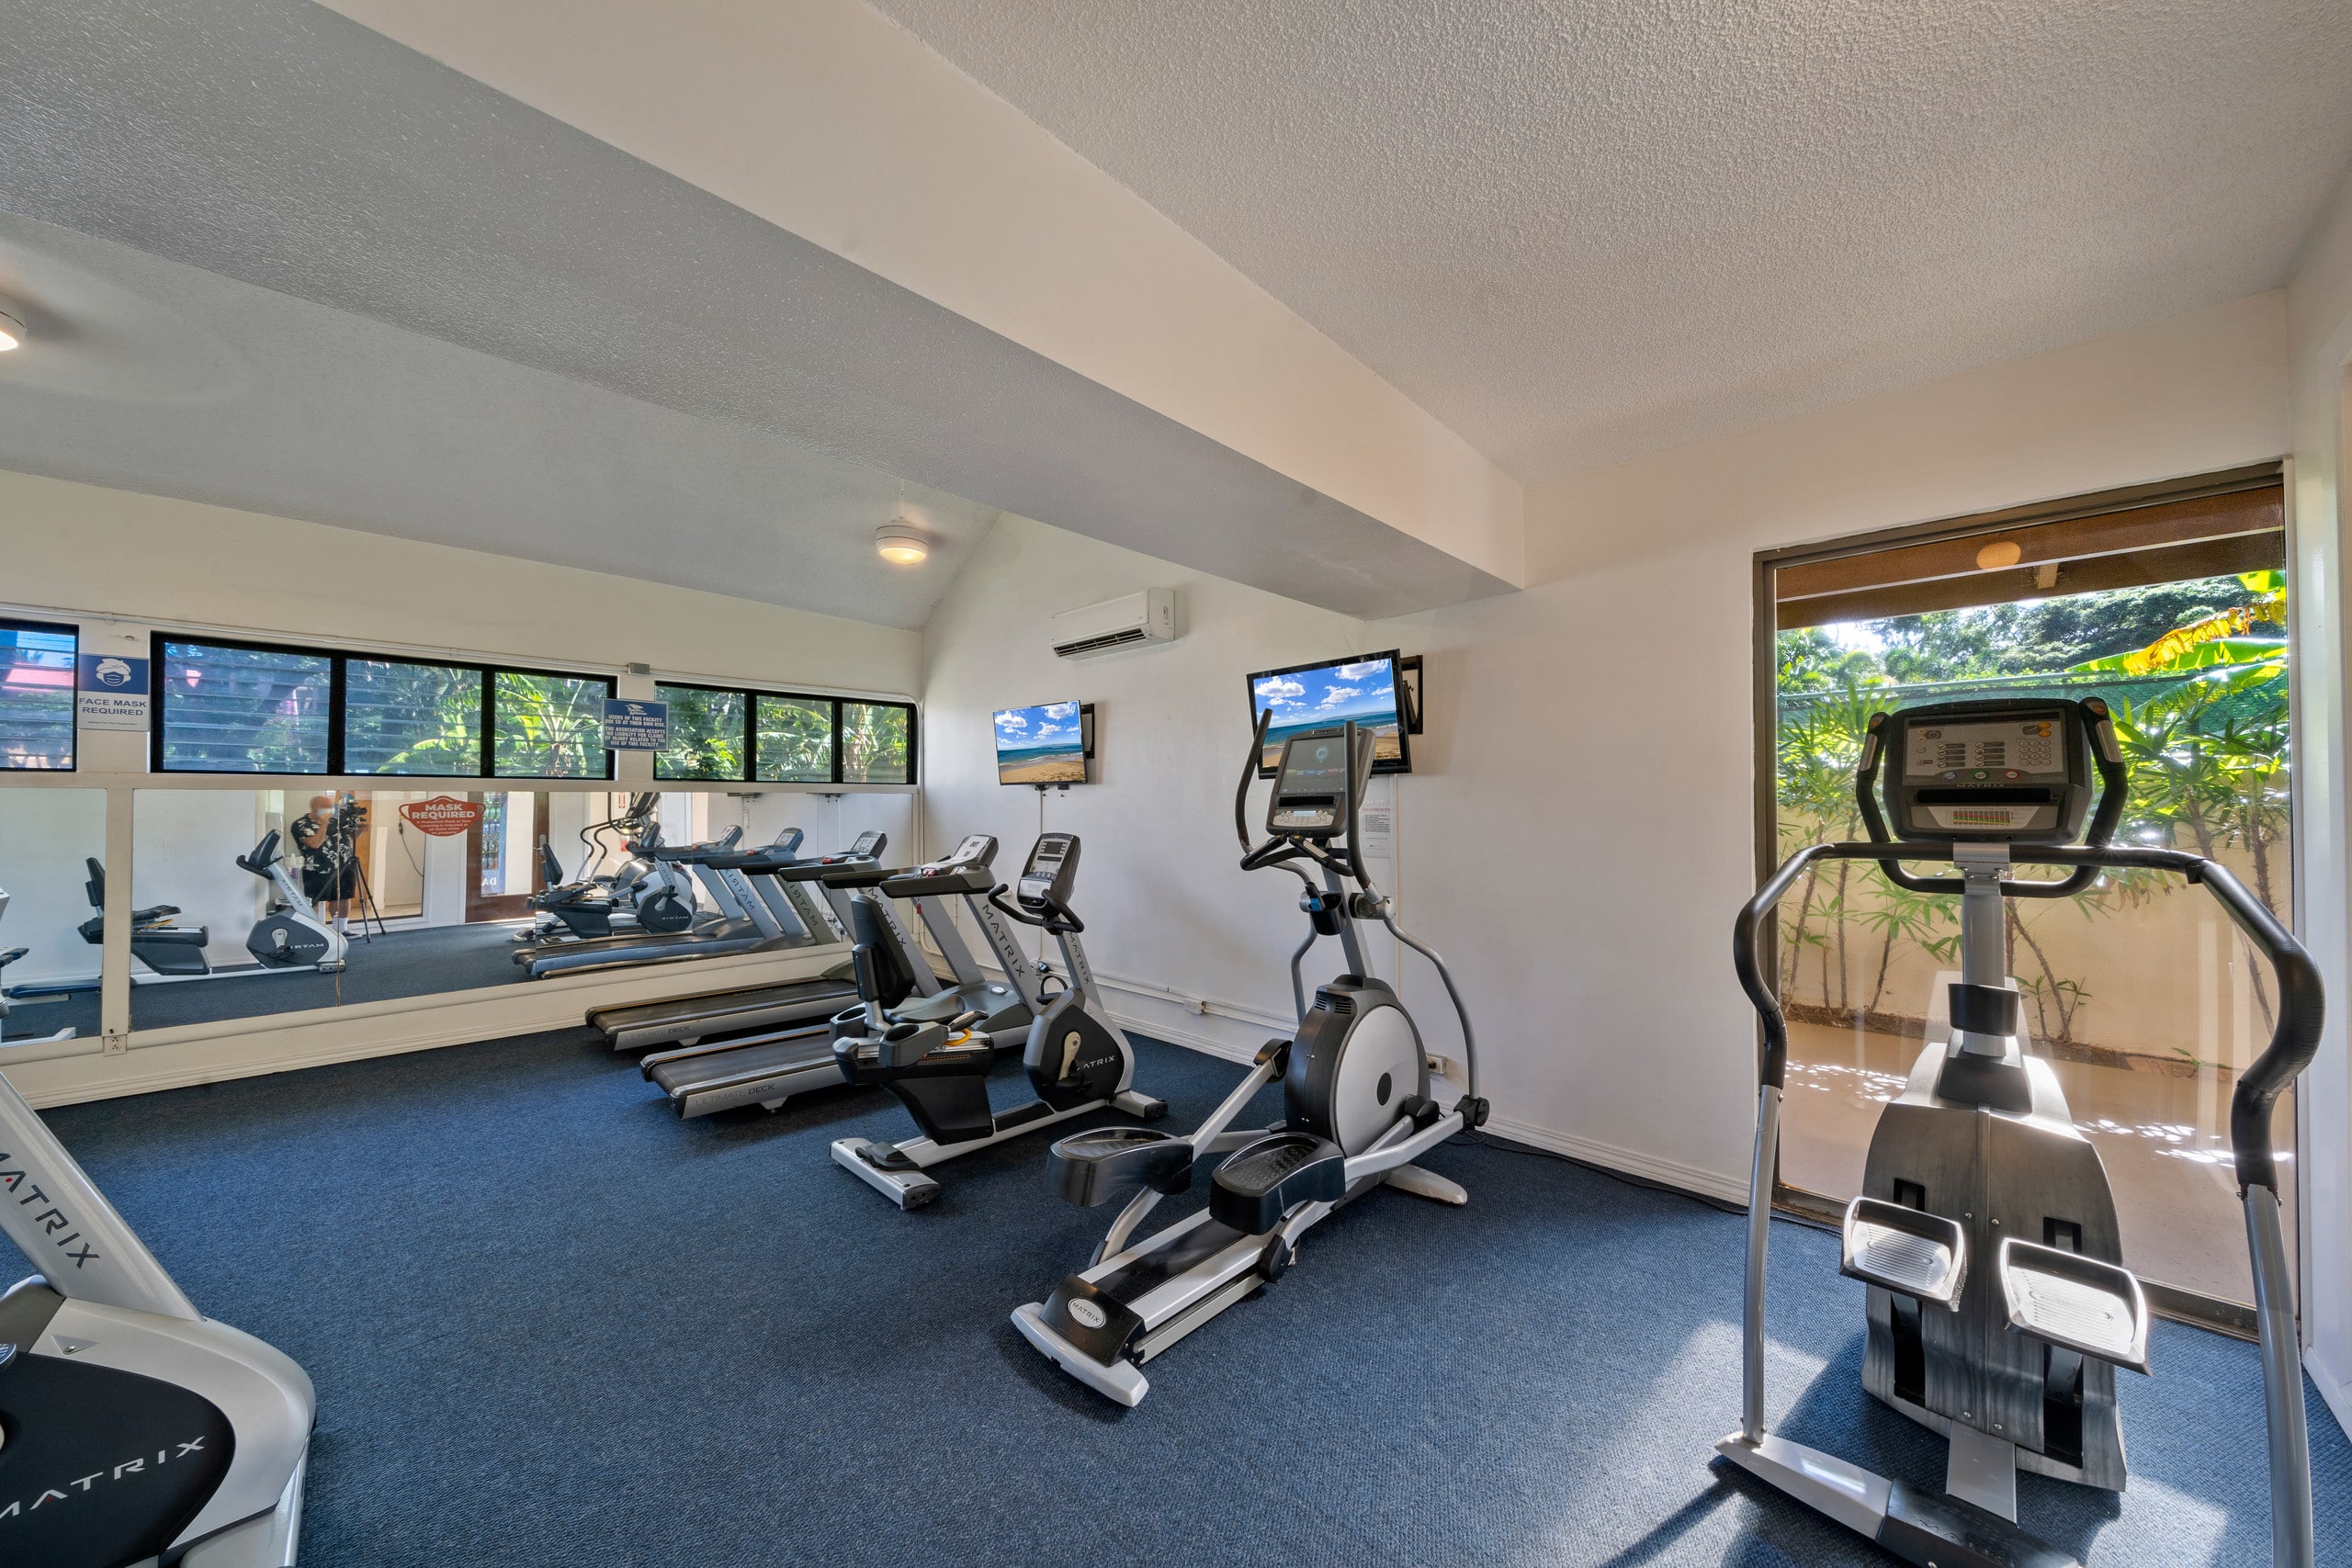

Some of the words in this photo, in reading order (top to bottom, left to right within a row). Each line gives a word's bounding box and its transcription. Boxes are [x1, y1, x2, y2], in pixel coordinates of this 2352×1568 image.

[82, 706, 143, 716] REQUIRED
[412, 811, 476, 819] REQUIRED
[982, 904, 1025, 977] MATRIX
[1069, 931, 1091, 985] MATRIX
[668, 1025, 690, 1034] DECK
[1077, 1055, 1115, 1071] ATRIX
[695, 1089, 747, 1106] ULTIMATE
[748, 1083, 775, 1095] DECK
[1073, 1302, 1099, 1323] MATRIX
